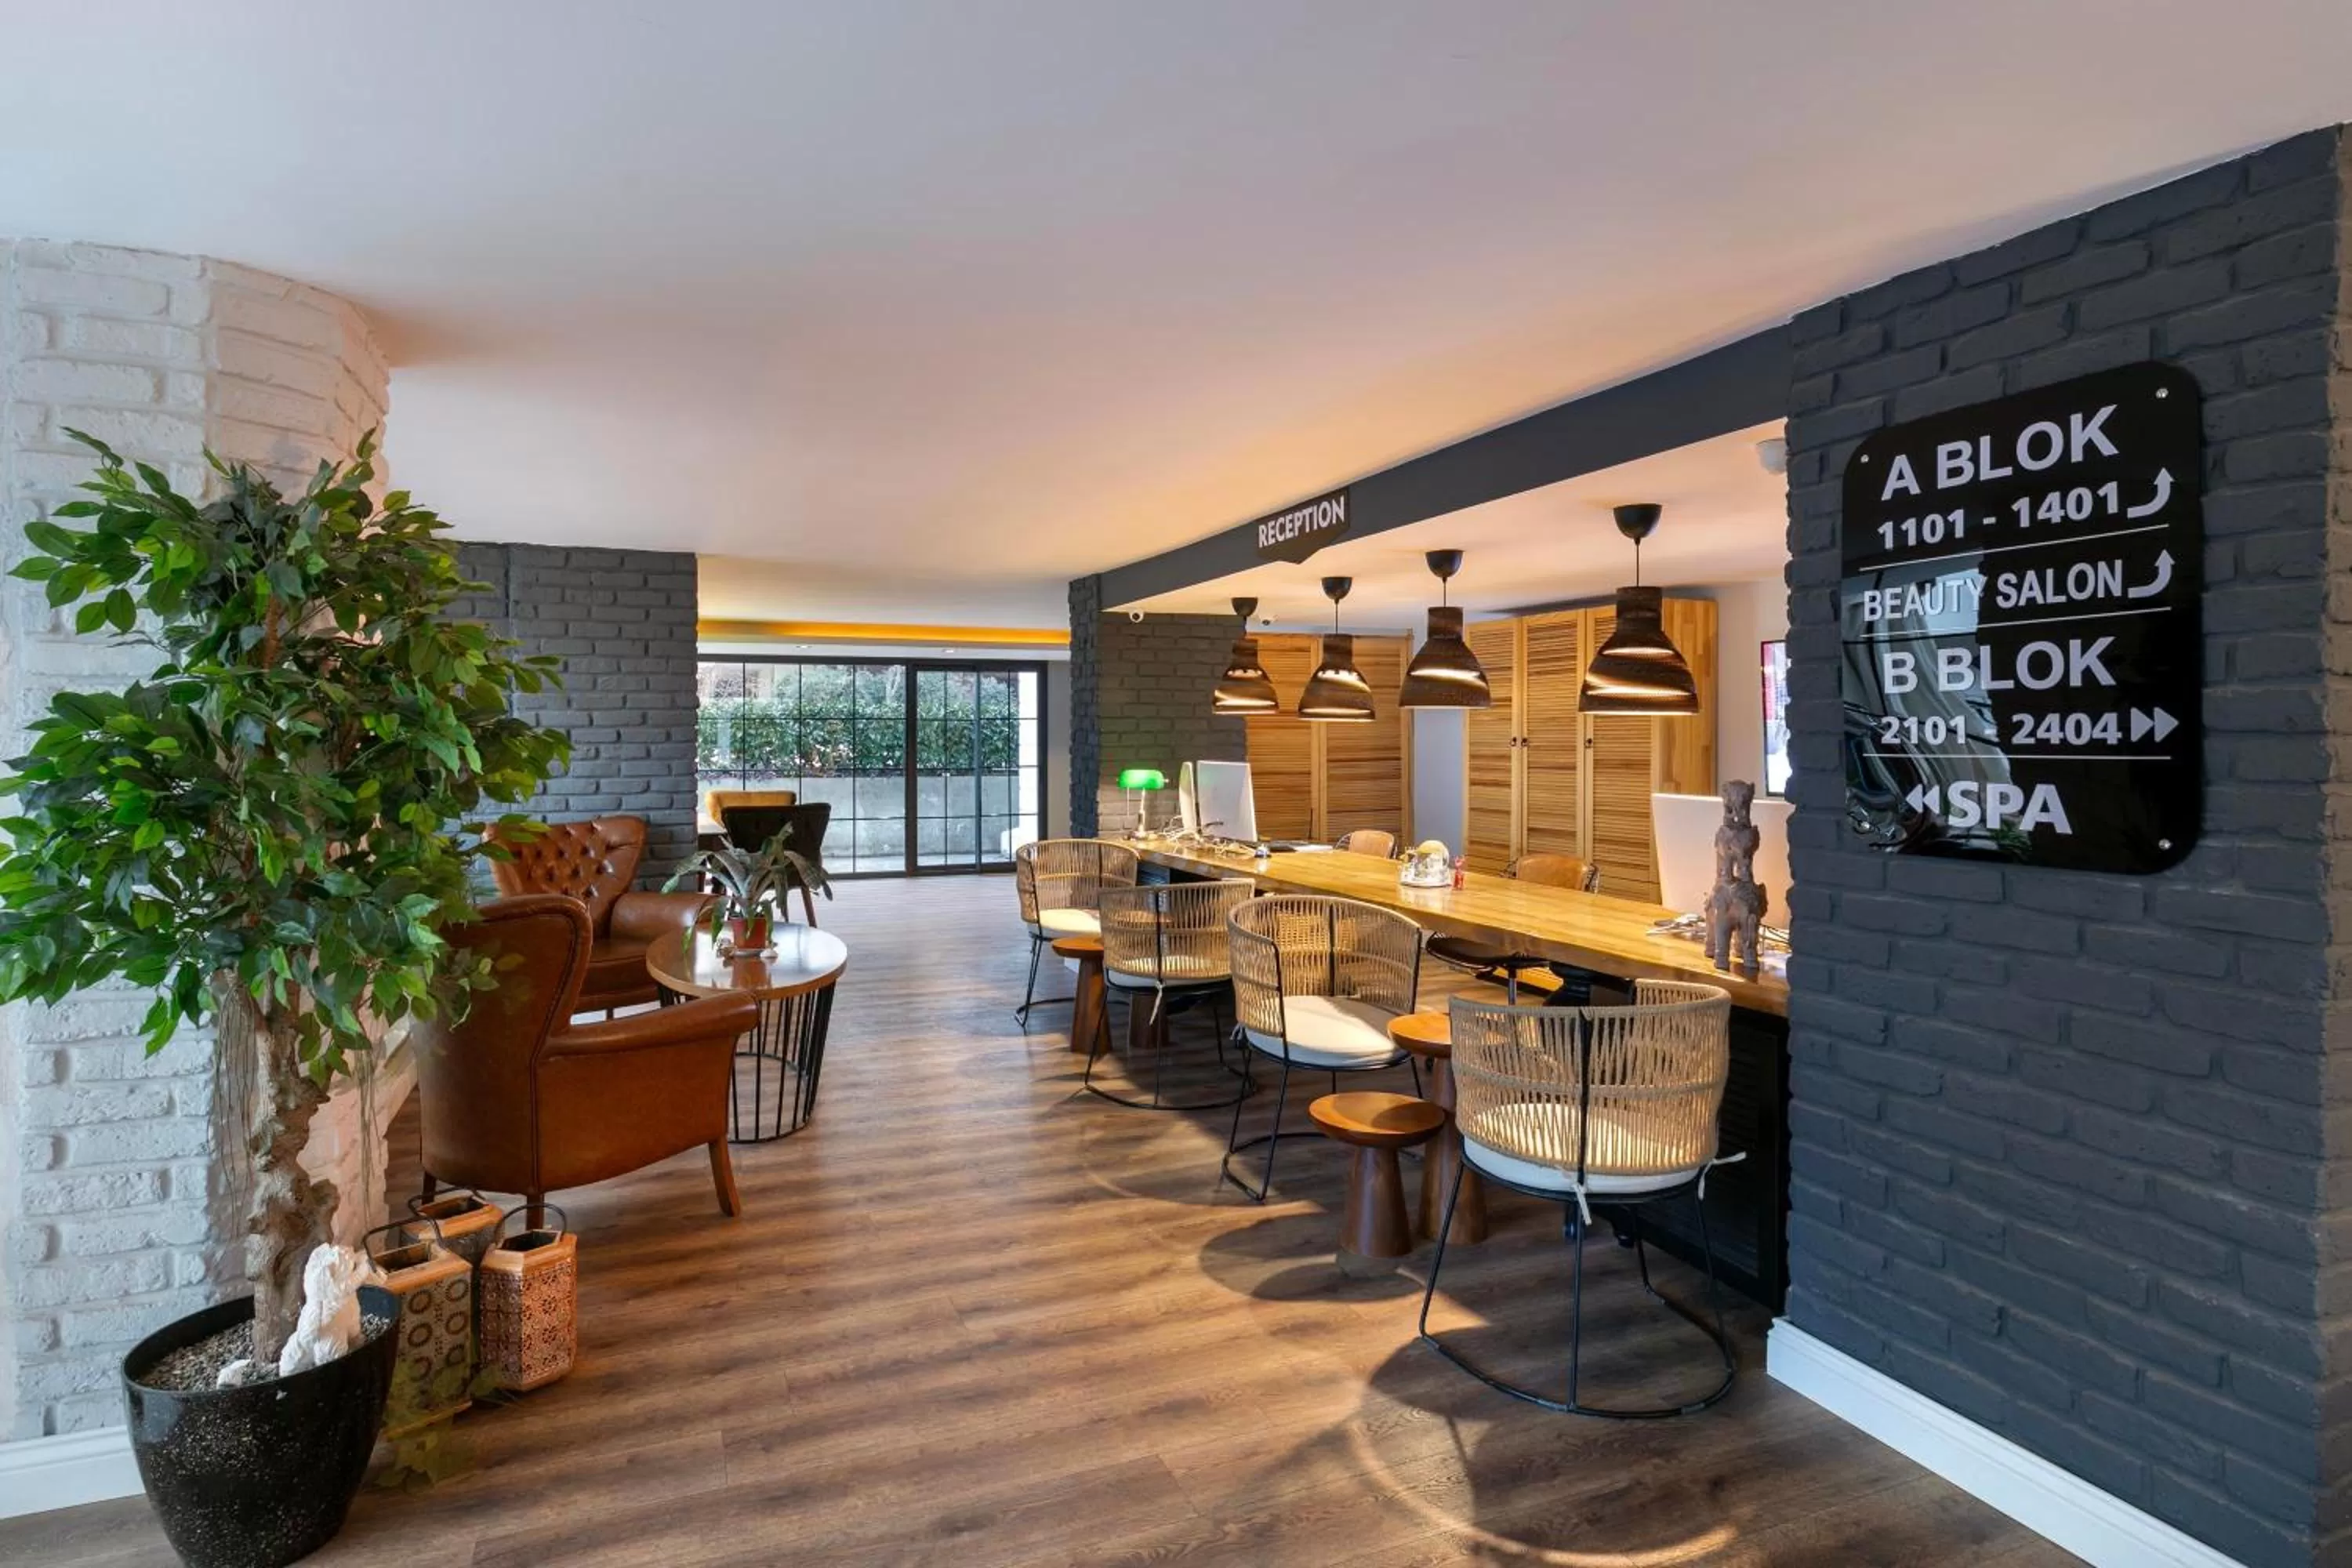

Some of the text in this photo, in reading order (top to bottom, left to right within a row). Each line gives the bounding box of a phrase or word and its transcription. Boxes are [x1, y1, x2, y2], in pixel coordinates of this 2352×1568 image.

[1882, 405, 2119, 500] A BLOK
[1258, 495, 1345, 548] RECEPTION
[1878, 509, 1964, 549] 1101
[2011, 481, 2118, 528] 1401
[1864, 559, 2122, 621] BEAUTY SALON
[1884, 637, 2116, 694] B BLOK
[1882, 715, 1967, 745] 2101
[2011, 713, 2122, 746] 2404
[1947, 781, 2072, 834] SPA
